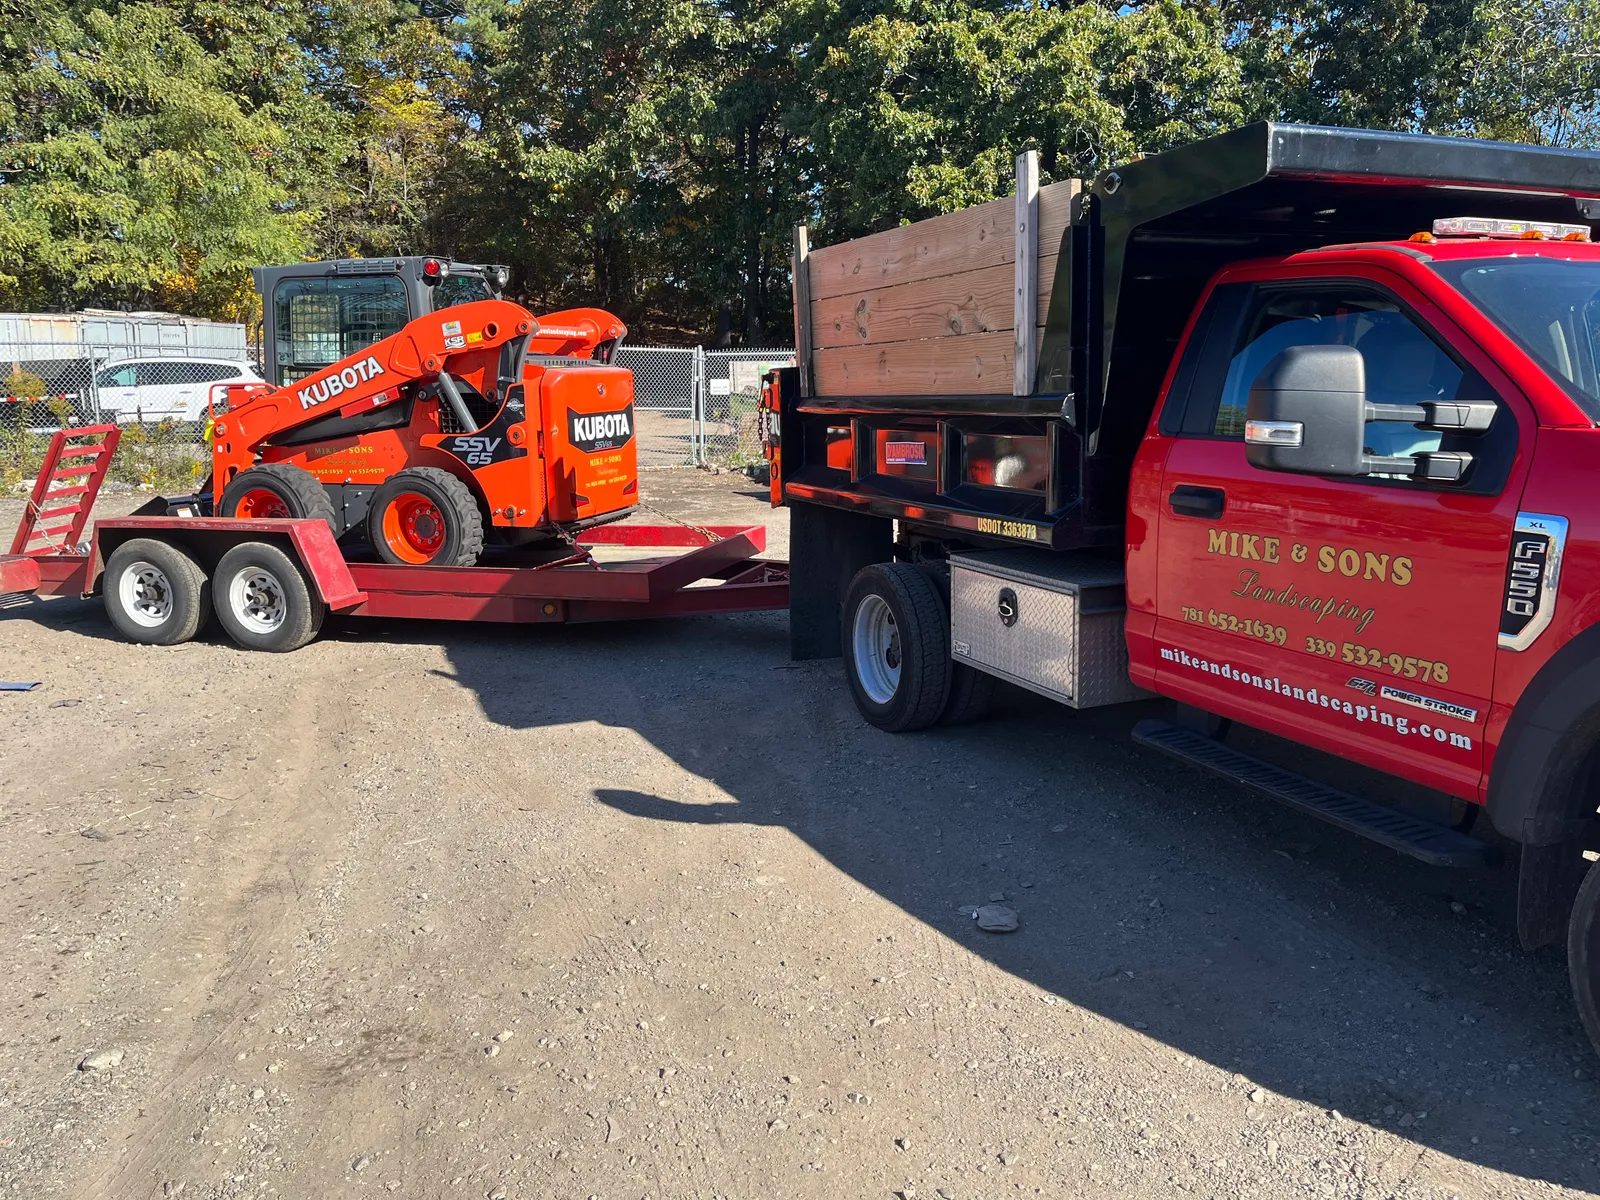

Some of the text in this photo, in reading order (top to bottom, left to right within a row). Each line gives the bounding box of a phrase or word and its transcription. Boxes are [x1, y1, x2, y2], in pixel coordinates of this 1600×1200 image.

[444, 335, 465, 345] KSR
[297, 356, 385, 410] KUBOTA
[573, 413, 631, 442] KUBOTA
[314, 447, 339, 455] MIKE
[348, 446, 374, 454] SONS
[452, 436, 502, 452] SSV
[466, 452, 493, 465] 65
[589, 457, 604, 467] MIKE
[608, 455, 622, 463] SONS
[977, 517, 1037, 540] USDOT 3363873
[1529, 521, 1546, 529] XL
[1207, 528, 1413, 586] MIKE & SONS
[1506, 540, 1547, 617] F550
[1231, 568, 1376, 634] Landscaping
[1181, 606, 1449, 684] 781 652-1639 339 532-9578
[1160, 647, 1472, 751] mikeandsonslandscaping.com
[1383, 687, 1473, 718] POWER STROKE
